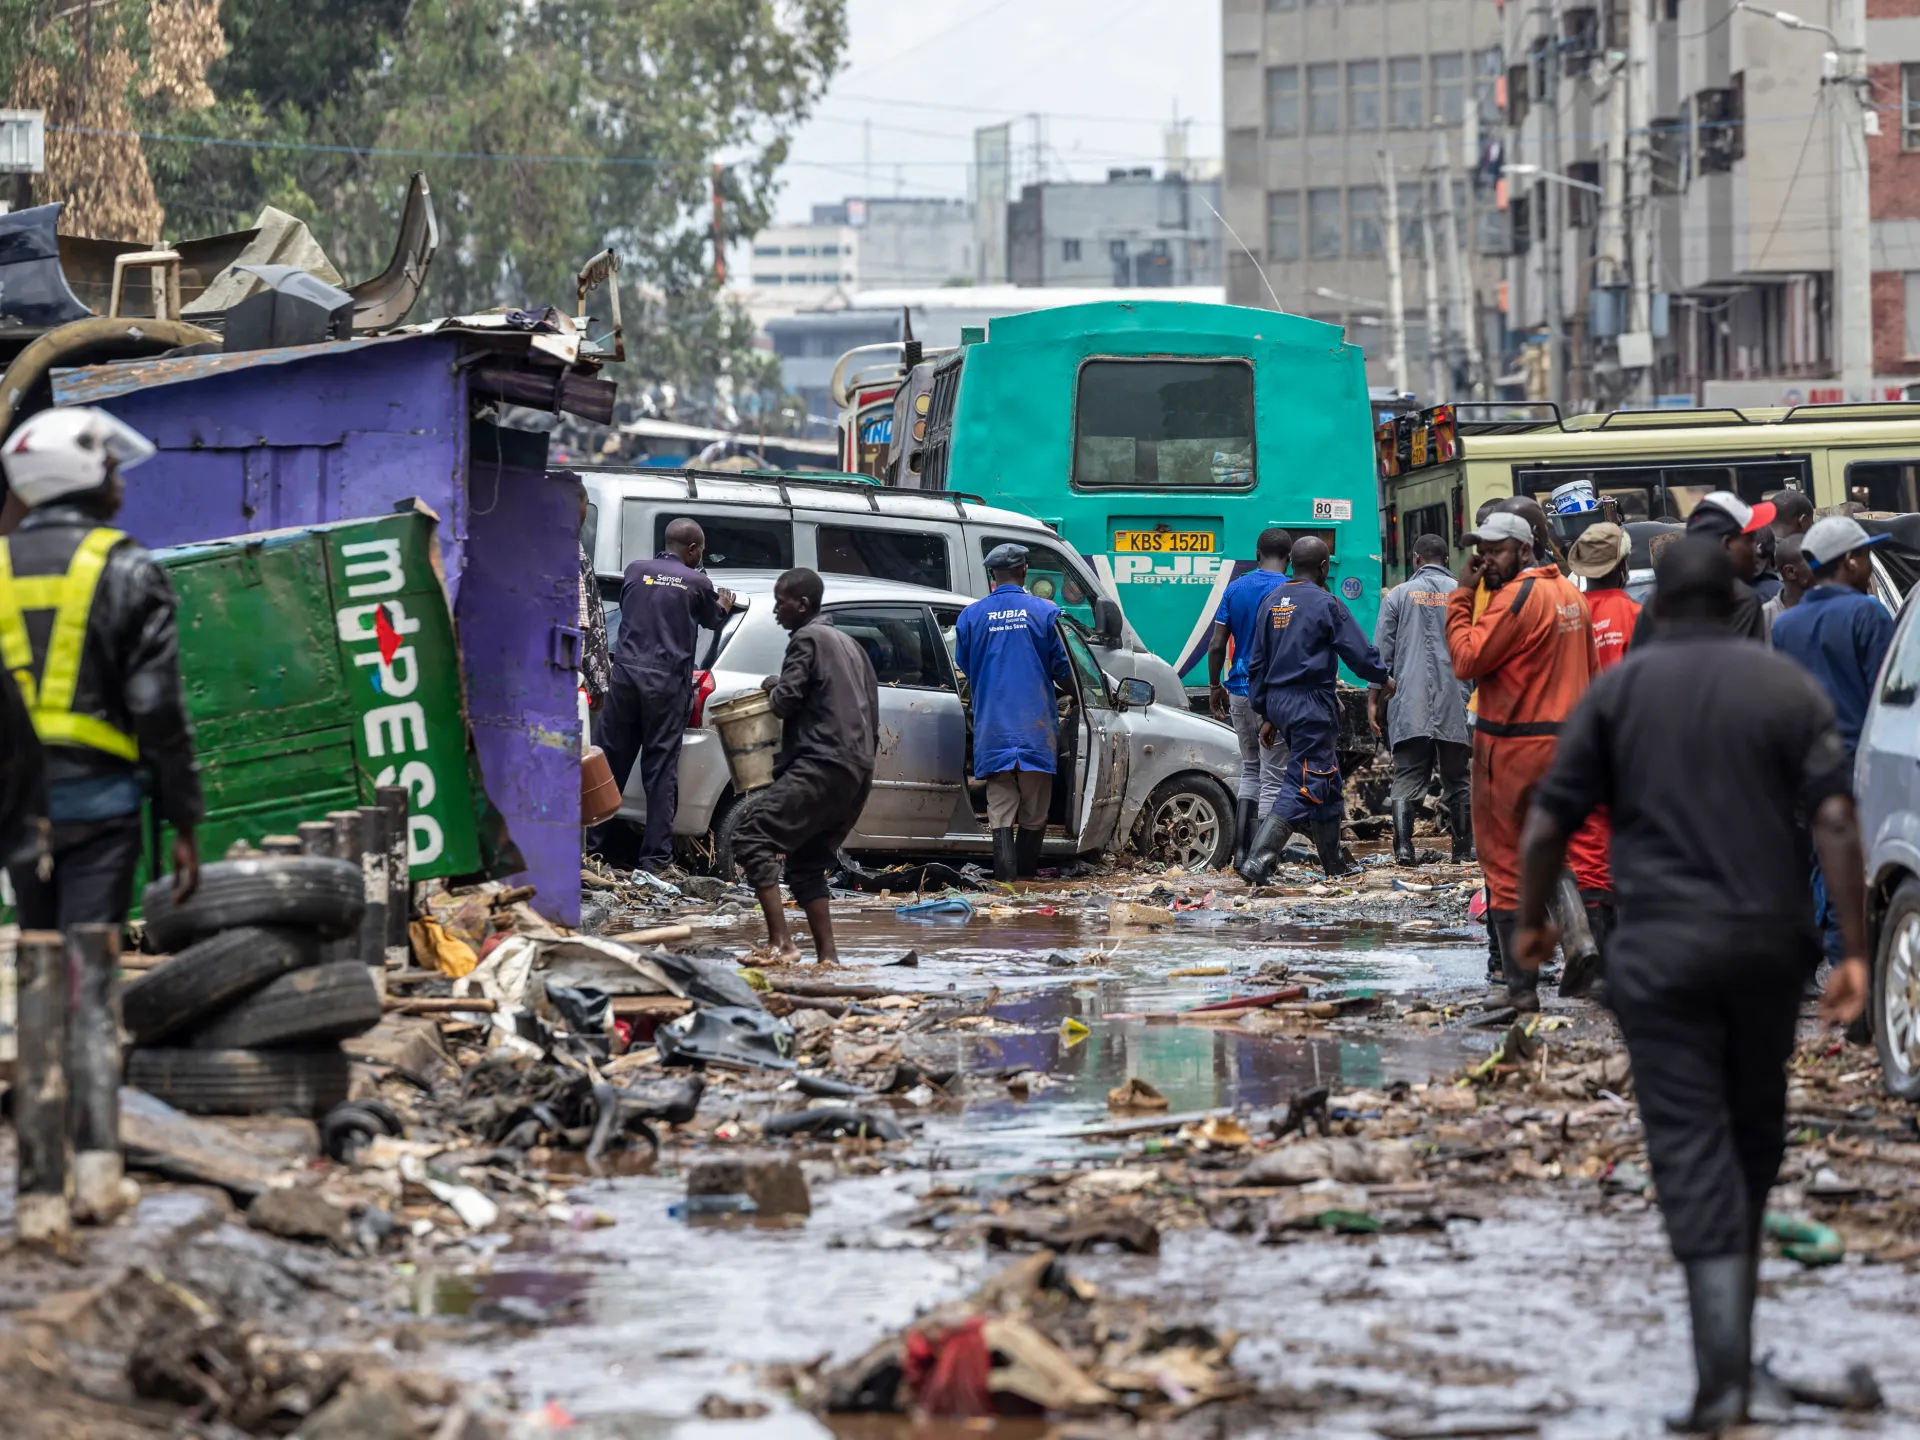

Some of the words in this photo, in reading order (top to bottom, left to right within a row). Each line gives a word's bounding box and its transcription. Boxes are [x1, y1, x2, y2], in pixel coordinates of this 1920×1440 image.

[1315, 503, 1332, 514] 80
[1130, 533, 1162, 551] KBS
[1169, 533, 1209, 551] 152D
[1114, 555, 1222, 584] PJE
[656, 574, 683, 584] Sensei
[1132, 575, 1218, 585] services
[1344, 580, 1360, 591] 80
